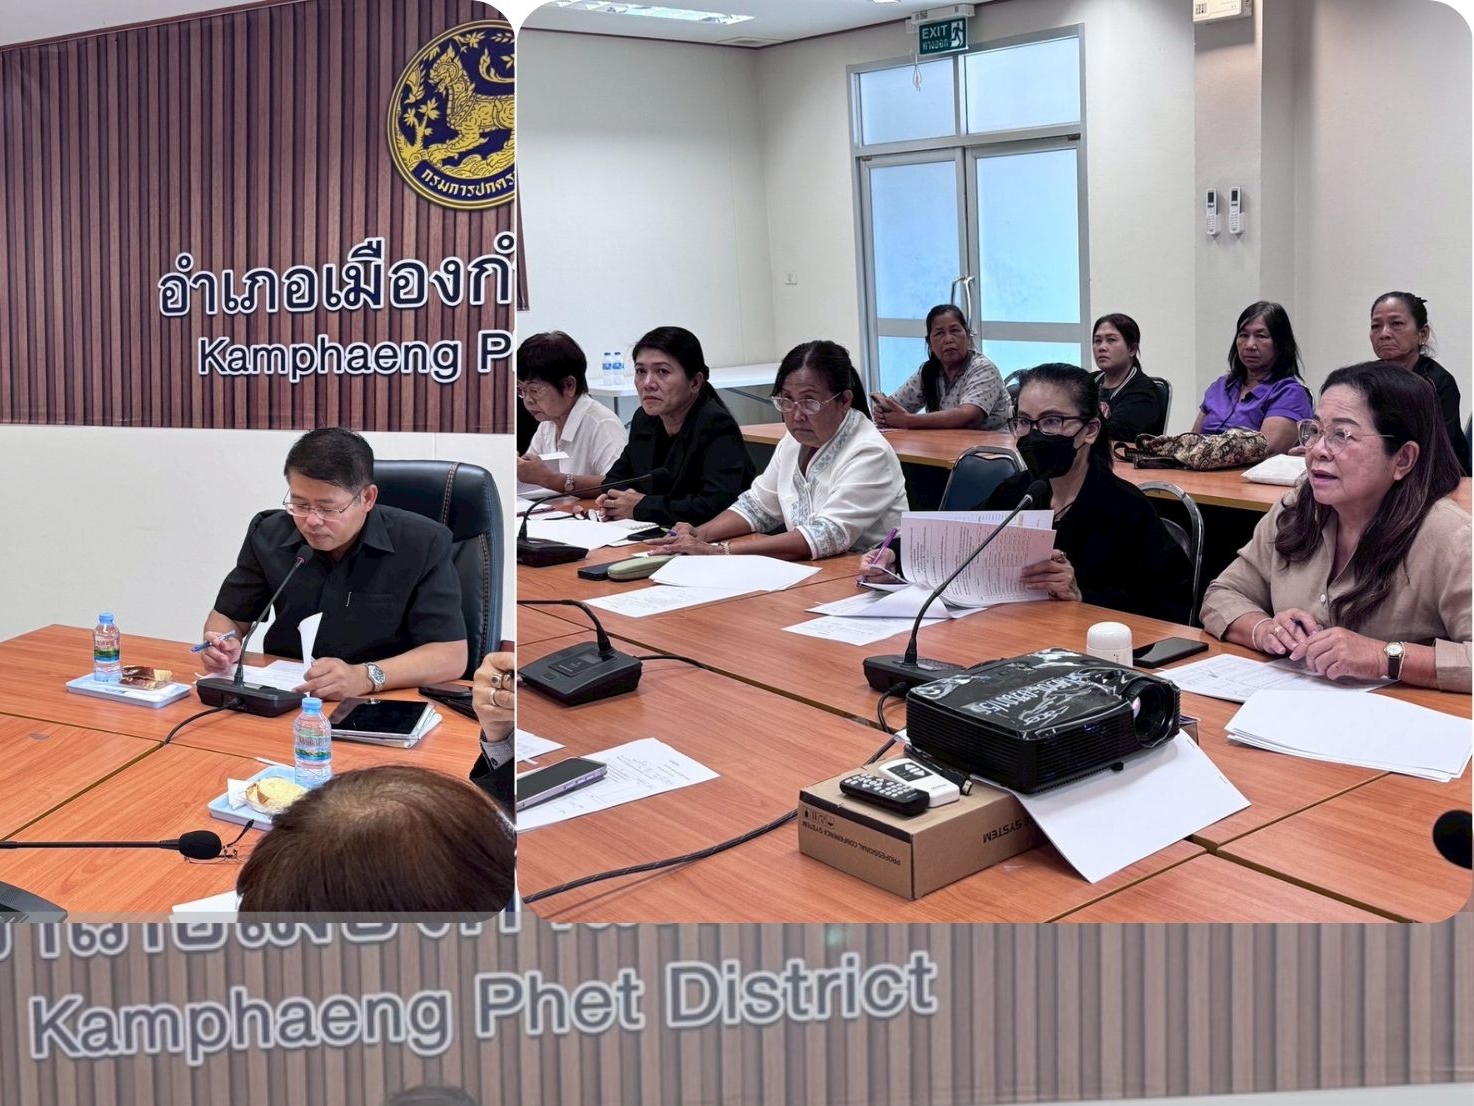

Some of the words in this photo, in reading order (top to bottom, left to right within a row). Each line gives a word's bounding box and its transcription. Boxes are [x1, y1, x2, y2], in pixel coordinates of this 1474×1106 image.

[922, 24, 948, 39] EXIT
[198, 334, 461, 383] Kamphaeng
[478, 330, 515, 374] P
[802, 820, 824, 834] SYSTEM
[983, 819, 1022, 844] SYSTEM
[857, 842, 901, 866] PROFESSIONAL
[29, 985, 452, 1067] Kamphaeng
[475, 968, 646, 1038] Phet
[666, 950, 938, 1028] District
